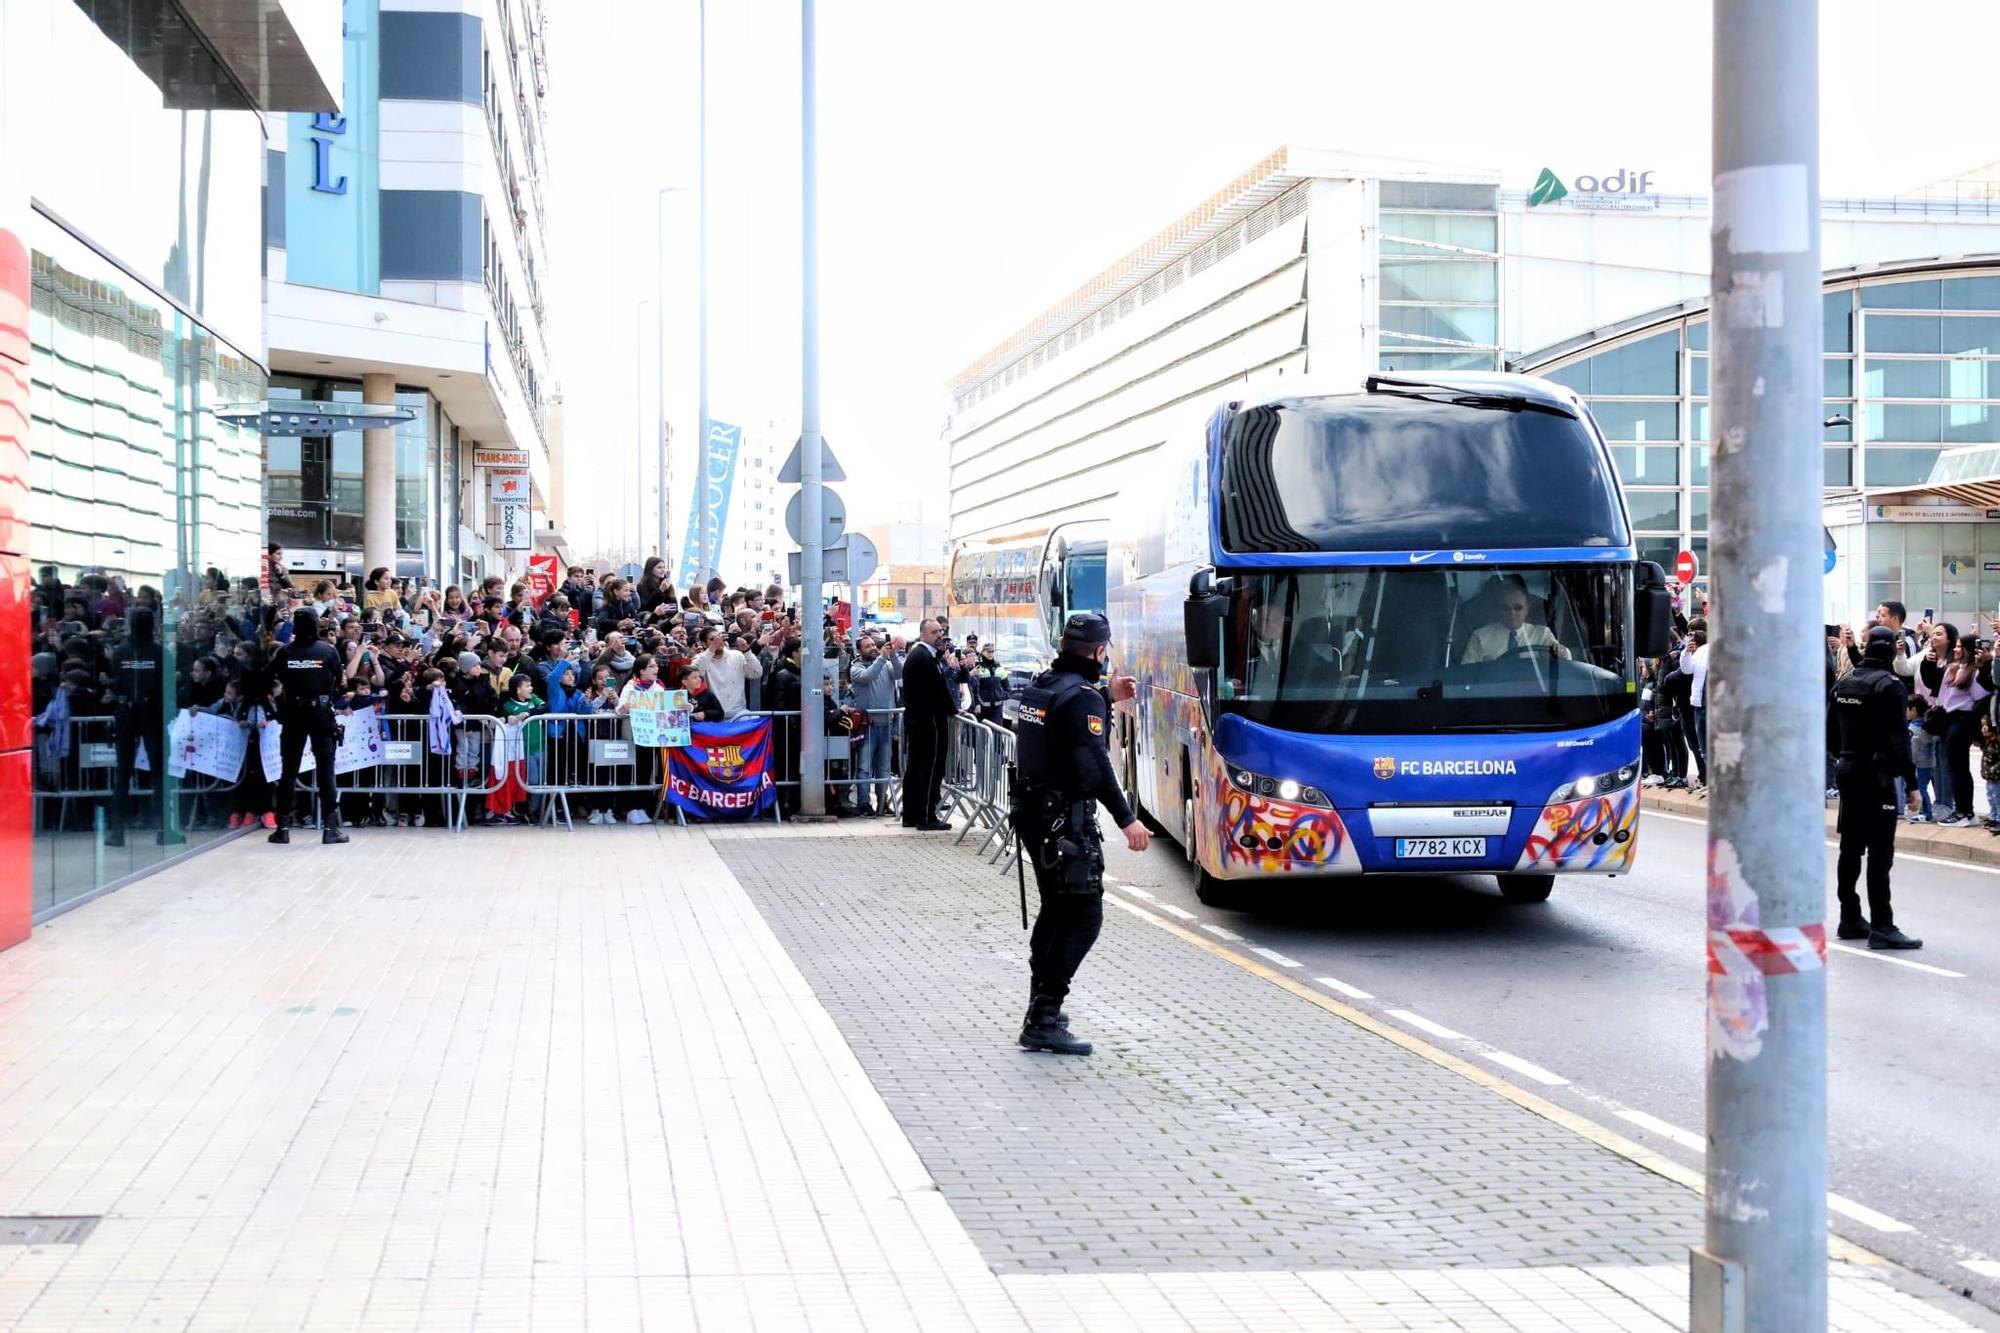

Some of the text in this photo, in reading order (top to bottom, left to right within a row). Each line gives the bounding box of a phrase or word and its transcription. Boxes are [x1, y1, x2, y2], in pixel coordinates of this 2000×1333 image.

[1575, 168, 1656, 193] adif
[475, 452, 528, 464] TRANS-MOBLE
[504, 505, 514, 544] MUDANZAS
[1019, 712, 1045, 726] NACIONAL
[1401, 760, 1517, 775] FC BARCELONA
[670, 771, 773, 809] FC BARCELA
[1453, 809, 1507, 817] NEOPLAN
[1408, 840, 1483, 855] 7782 KCX
